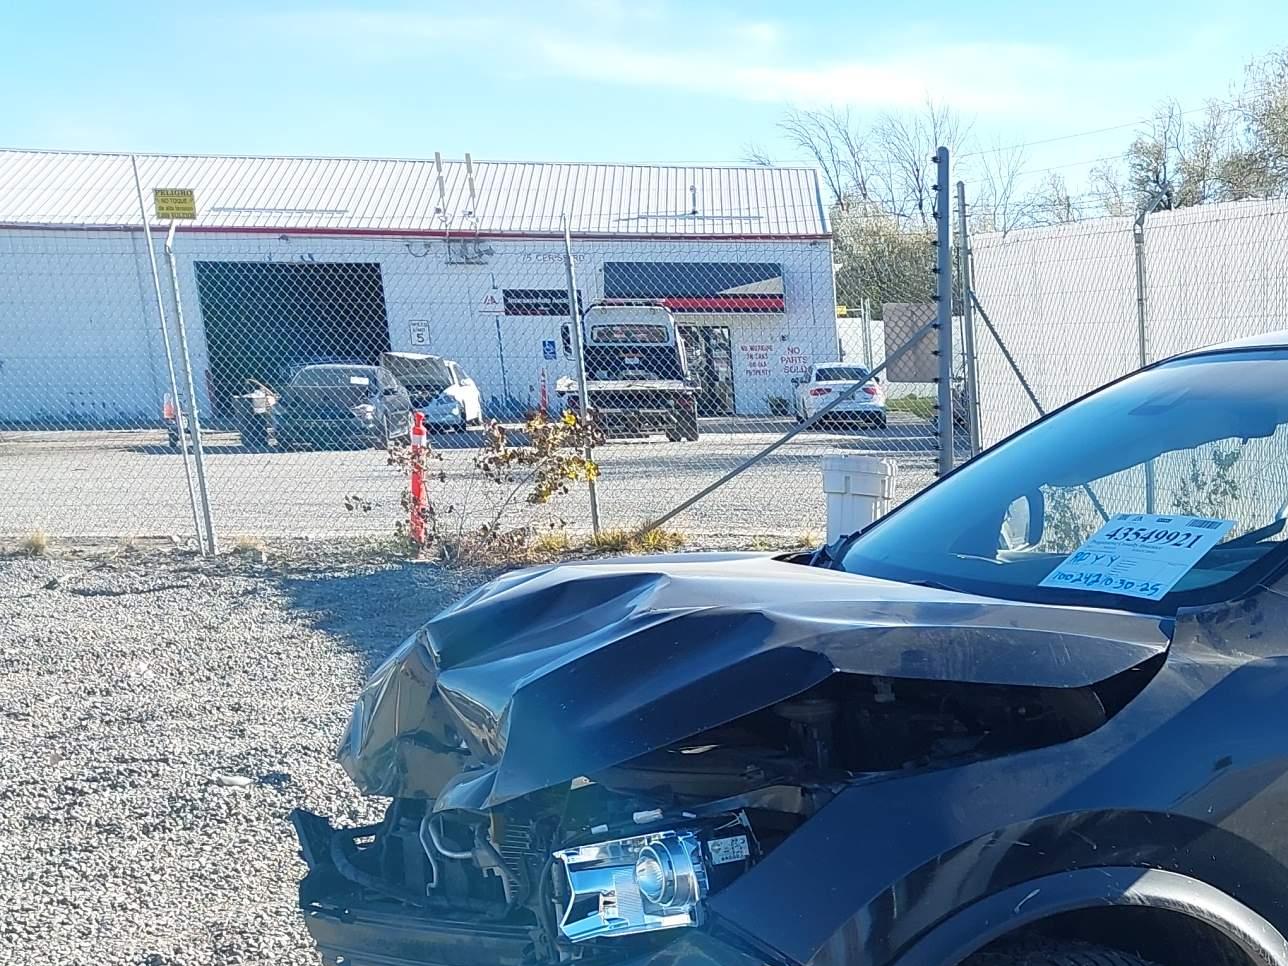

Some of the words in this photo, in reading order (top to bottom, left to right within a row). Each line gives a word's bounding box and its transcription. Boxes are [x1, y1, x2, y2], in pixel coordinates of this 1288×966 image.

[417, 333, 425, 343] 5
[787, 346, 801, 355] NO
[780, 356, 808, 364] PARTS
[783, 365, 808, 374] SOLD
[1105, 526, 1204, 549] 43549921
